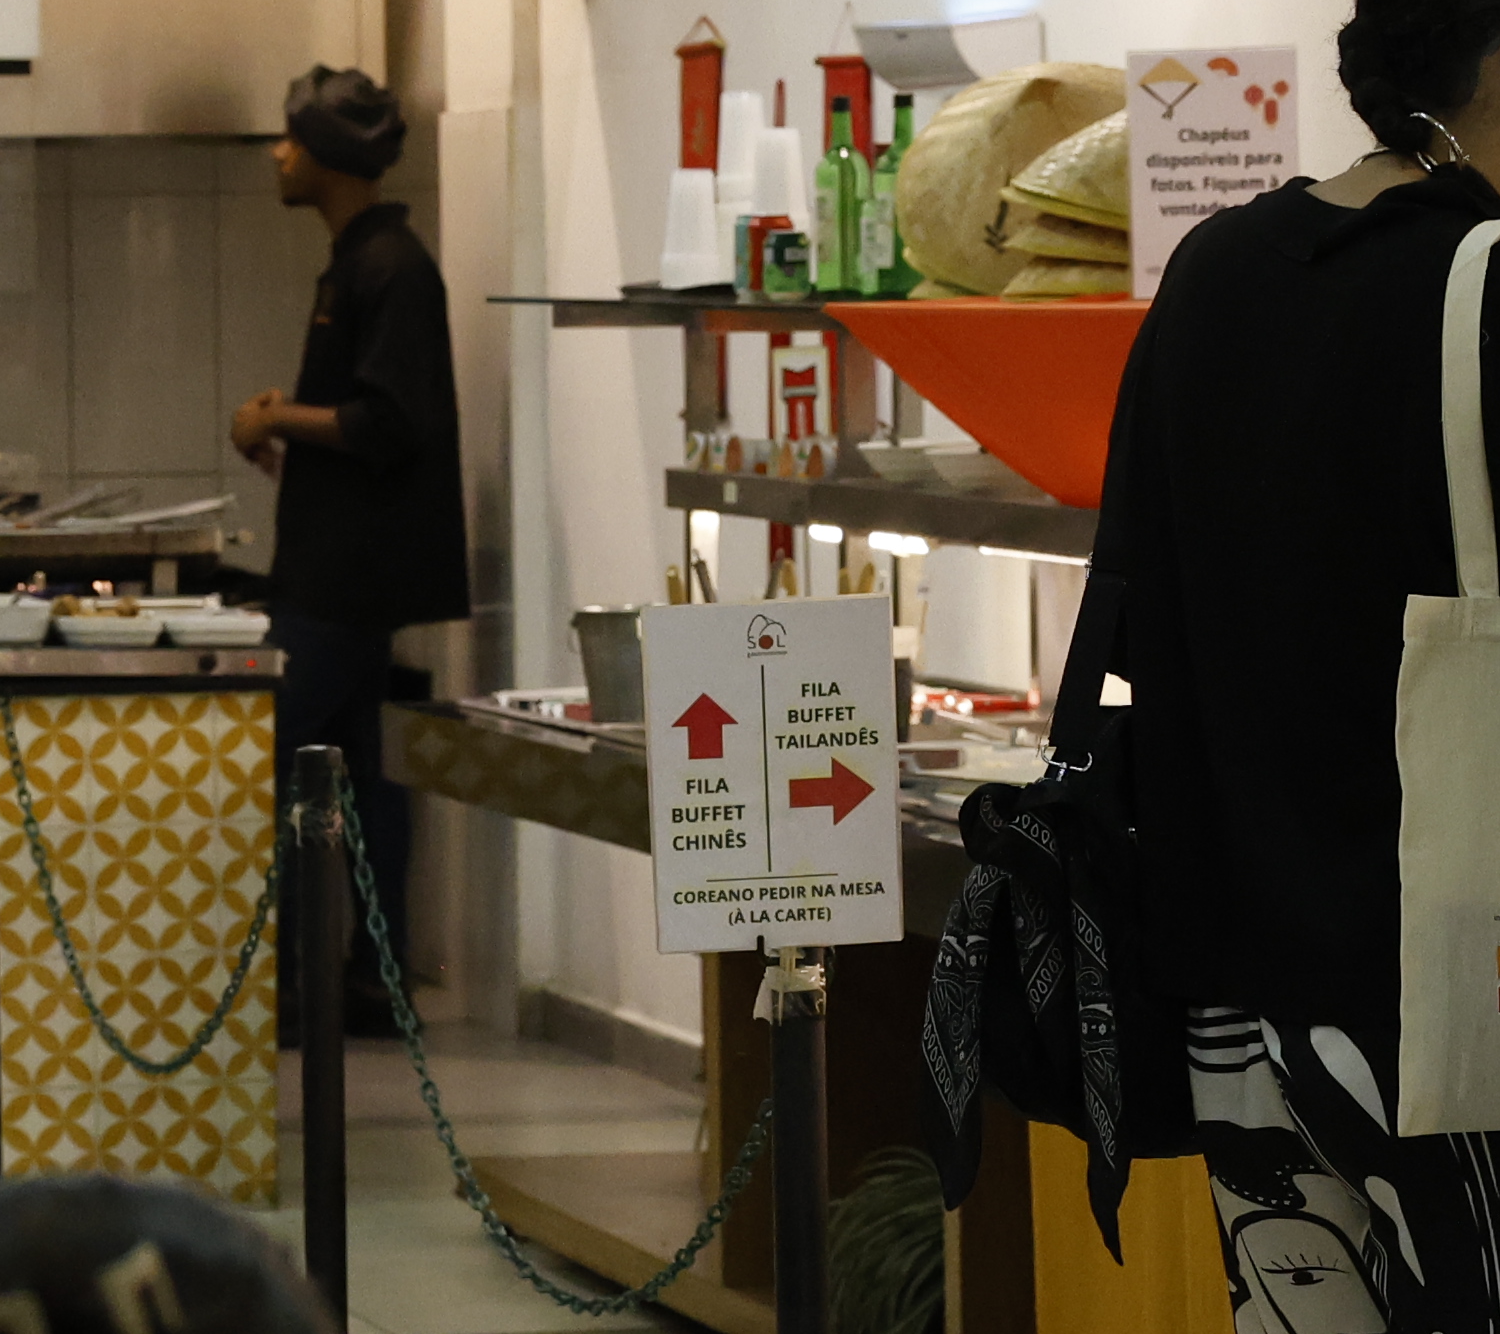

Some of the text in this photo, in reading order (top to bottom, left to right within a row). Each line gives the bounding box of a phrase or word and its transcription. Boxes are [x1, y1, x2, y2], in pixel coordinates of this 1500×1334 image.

[1178, 128, 1250, 145] Chapéus
[1245, 153, 1283, 168] para
[1203, 176, 1265, 194] Fiquem
[801, 681, 842, 698] FILA
[788, 706, 856, 724] BUFFET
[775, 727, 880, 750] TAILANDÊS
[686, 778, 730, 794] FILA
[672, 804, 746, 824] BUFFET
[672, 829, 747, 851] CHINÊS
[674, 881, 885, 905] COREANO PEDIR NA MESA
[728, 906, 832, 926] (À LA CARTE)
